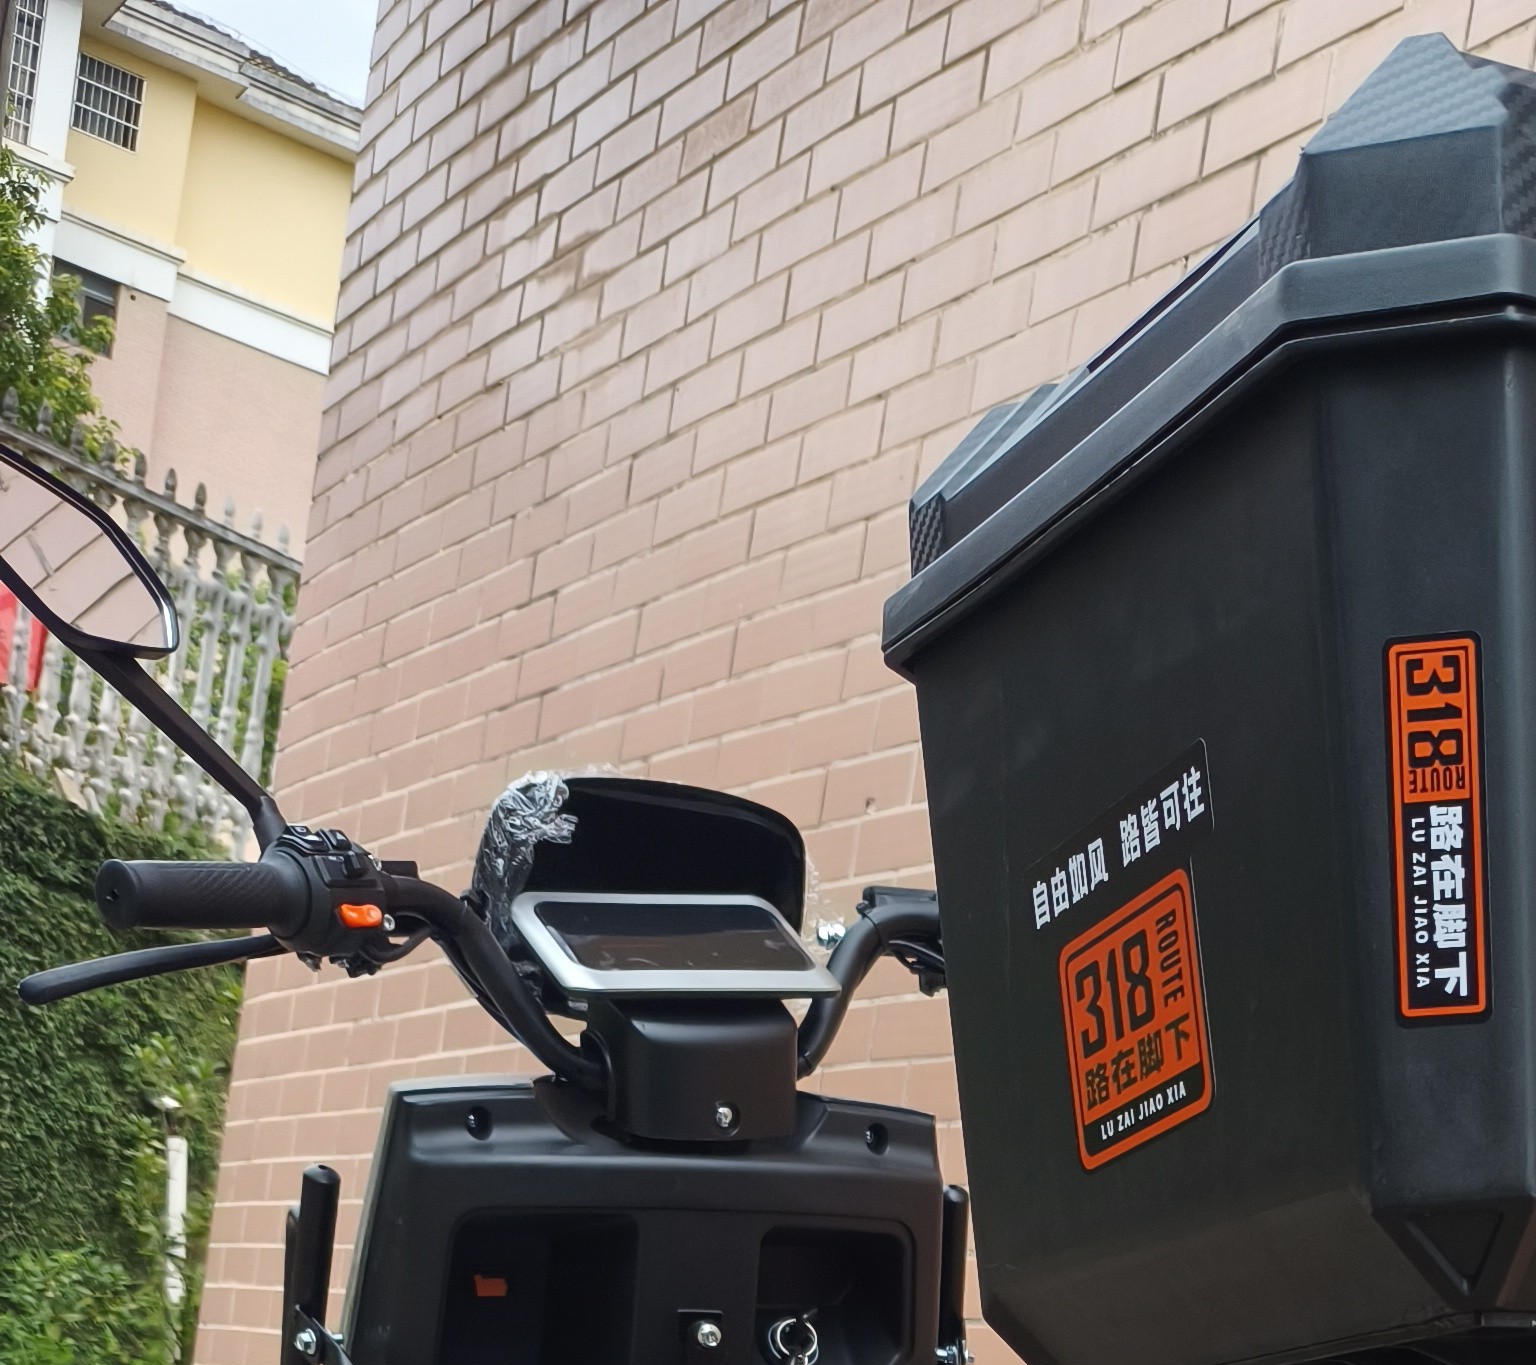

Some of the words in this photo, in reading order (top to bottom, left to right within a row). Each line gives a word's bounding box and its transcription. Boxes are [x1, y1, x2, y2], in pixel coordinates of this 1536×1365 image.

[1403, 654, 1465, 770] 318
[1408, 765, 1467, 794] ROUTE
[1031, 838, 1109, 930] 自由如风
[1119, 766, 1206, 868] 路皆可往
[1410, 816, 1426, 843] LU
[1412, 851, 1427, 887] ZAI
[1413, 894, 1430, 945] JIAO
[1430, 804, 1469, 997] 路在脚下
[1074, 928, 1157, 1060] 318
[1155, 908, 1186, 1009] ROUTE
[1415, 952, 1432, 989] XIA
[1084, 1012, 1191, 1111] 路在脚下
[1100, 1120, 1115, 1142] LU
[1116, 1109, 1136, 1132] ZAI
[1138, 1095, 1164, 1121] JIAO
[1166, 1081, 1188, 1109] XIA
